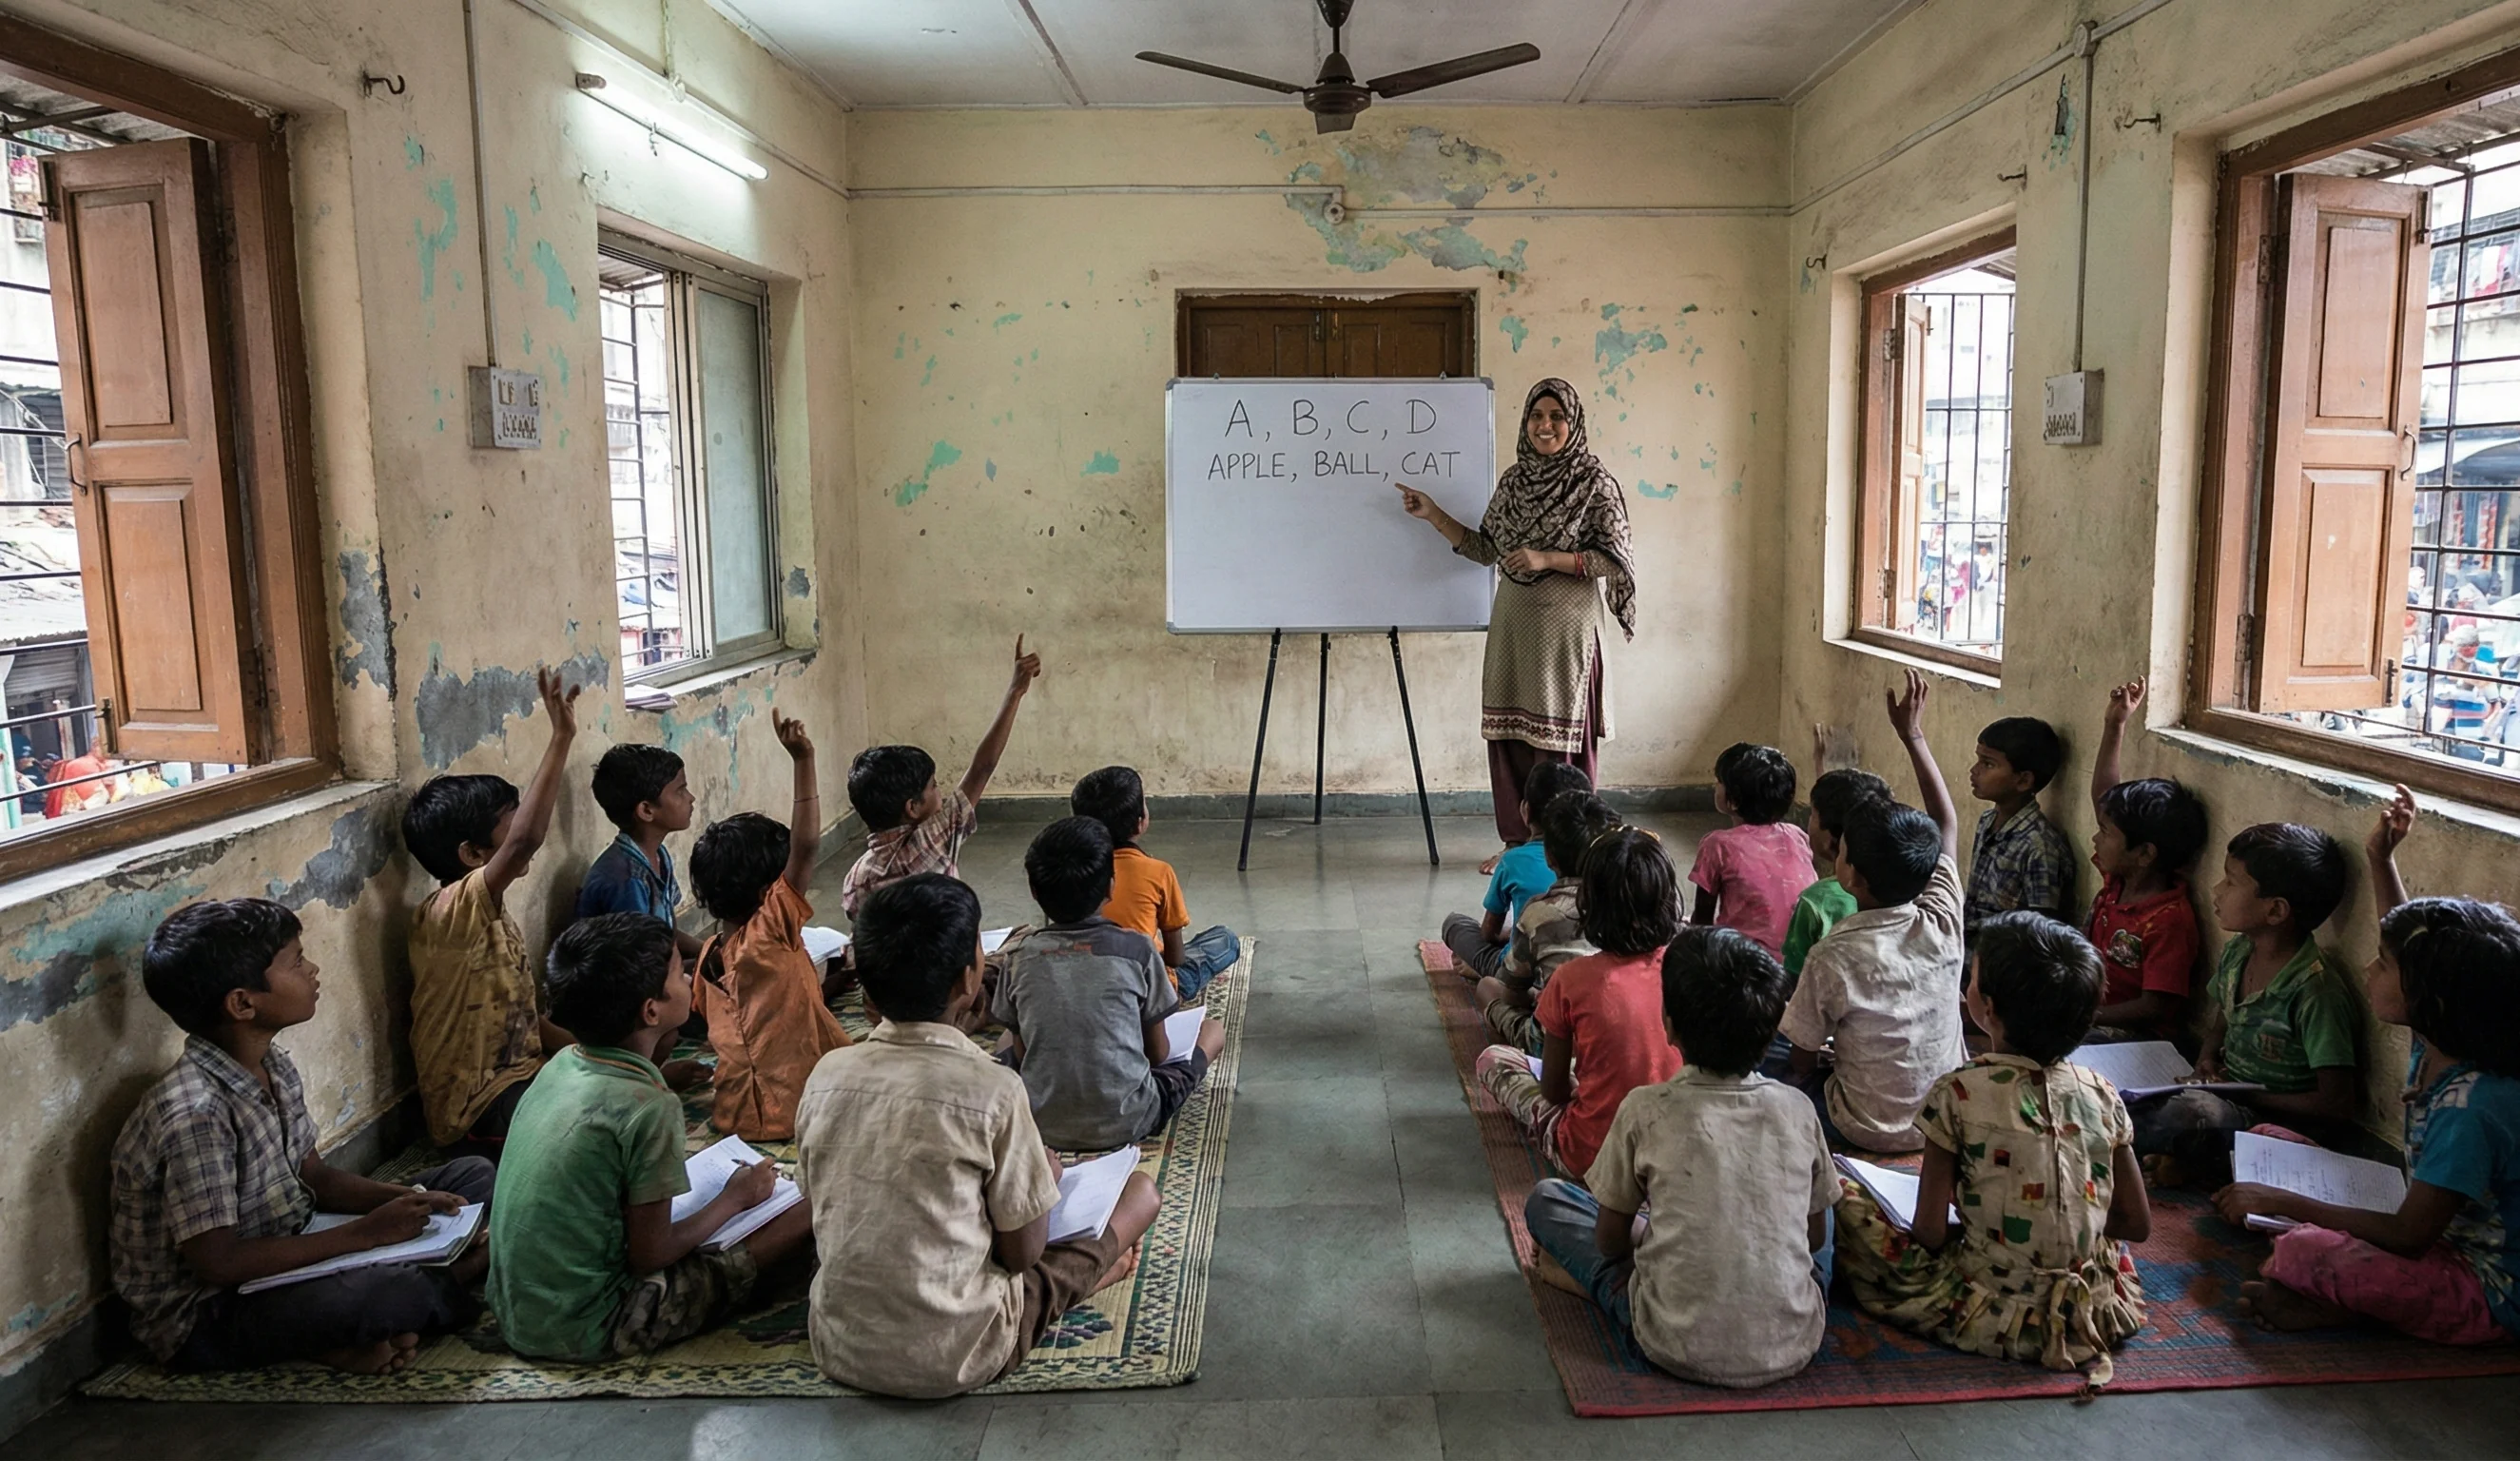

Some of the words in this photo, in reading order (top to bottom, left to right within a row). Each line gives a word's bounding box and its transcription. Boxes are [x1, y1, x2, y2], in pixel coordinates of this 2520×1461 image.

[1224, 399, 1271, 443] A,
[1292, 399, 1332, 441] B,
[1346, 399, 1389, 441] C,
[1405, 399, 1438, 435] D
[1207, 452, 1298, 483] APPLE,
[1314, 450, 1389, 483] BALL,
[1401, 451, 1462, 478] CAT
